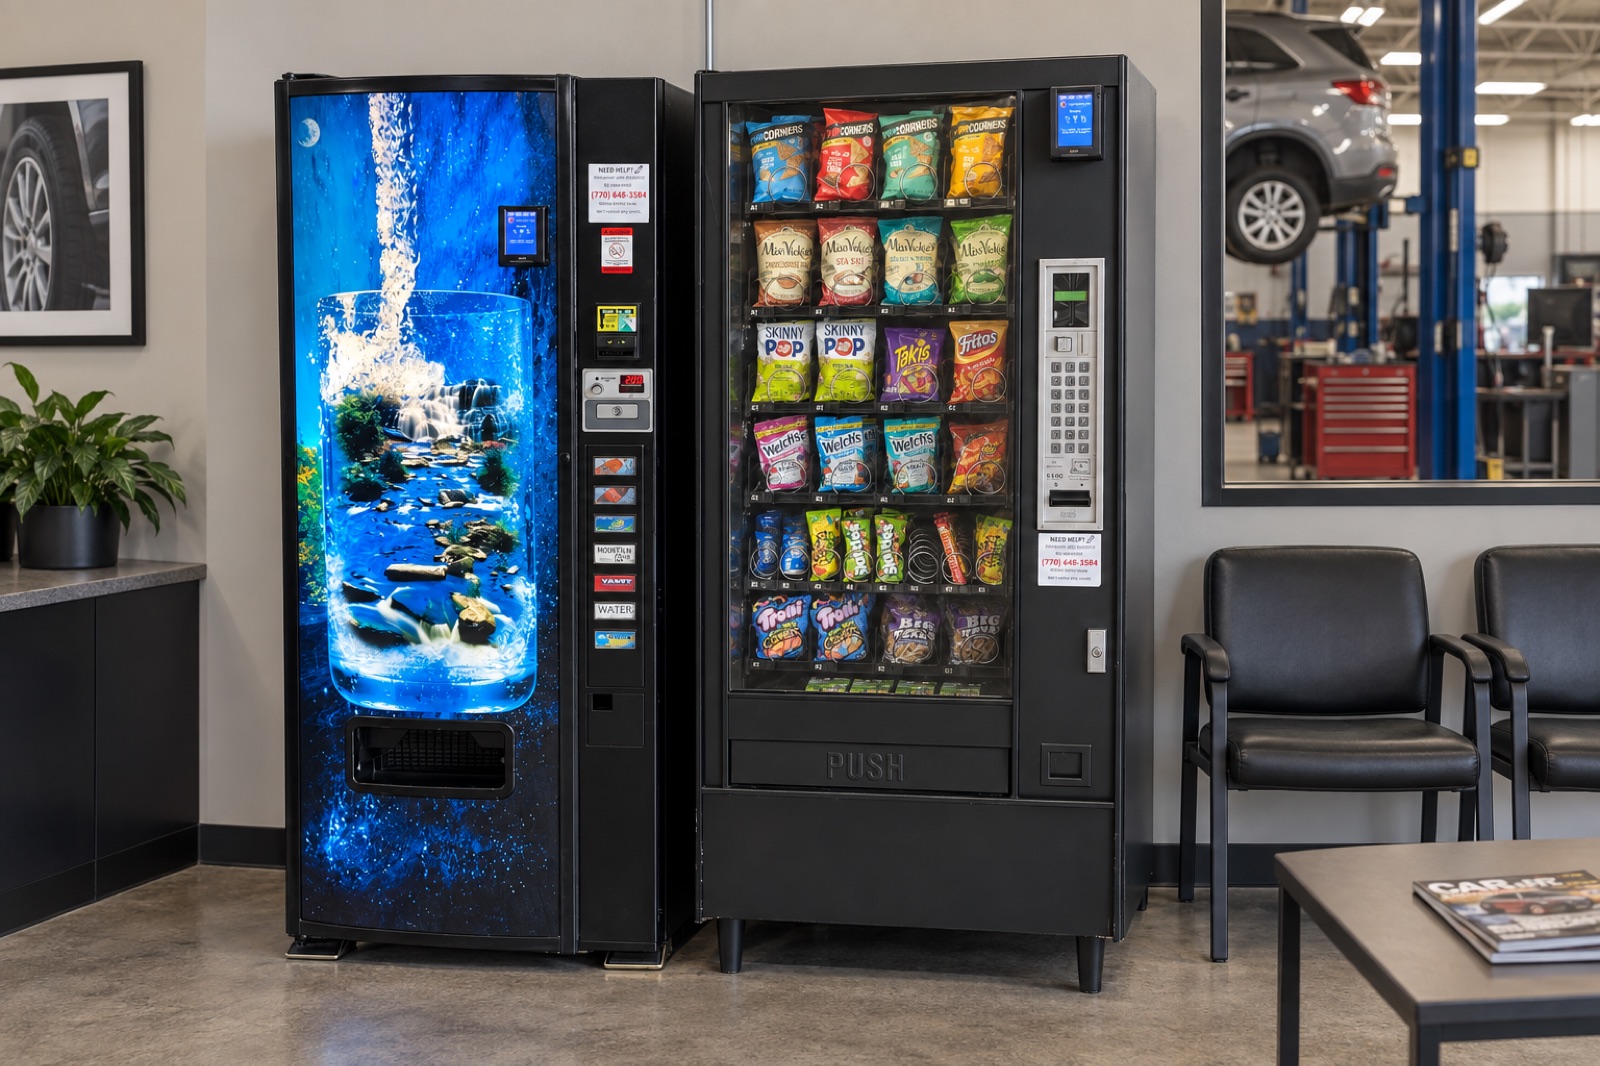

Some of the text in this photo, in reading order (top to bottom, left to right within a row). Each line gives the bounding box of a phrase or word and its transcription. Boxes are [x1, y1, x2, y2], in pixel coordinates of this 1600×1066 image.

[765, 326, 805, 339] SKINNY
[824, 324, 865, 337] SKINNY
[765, 339, 804, 357] POP
[824, 337, 865, 356] POP
[957, 331, 998, 355] Fritos
[894, 340, 931, 372] Takis
[598, 605, 633, 614] WATER
[757, 600, 803, 632] Trolli
[967, 615, 1000, 628] BIG
[827, 751, 904, 781] PUSH
[1428, 879, 1515, 894] CAR
